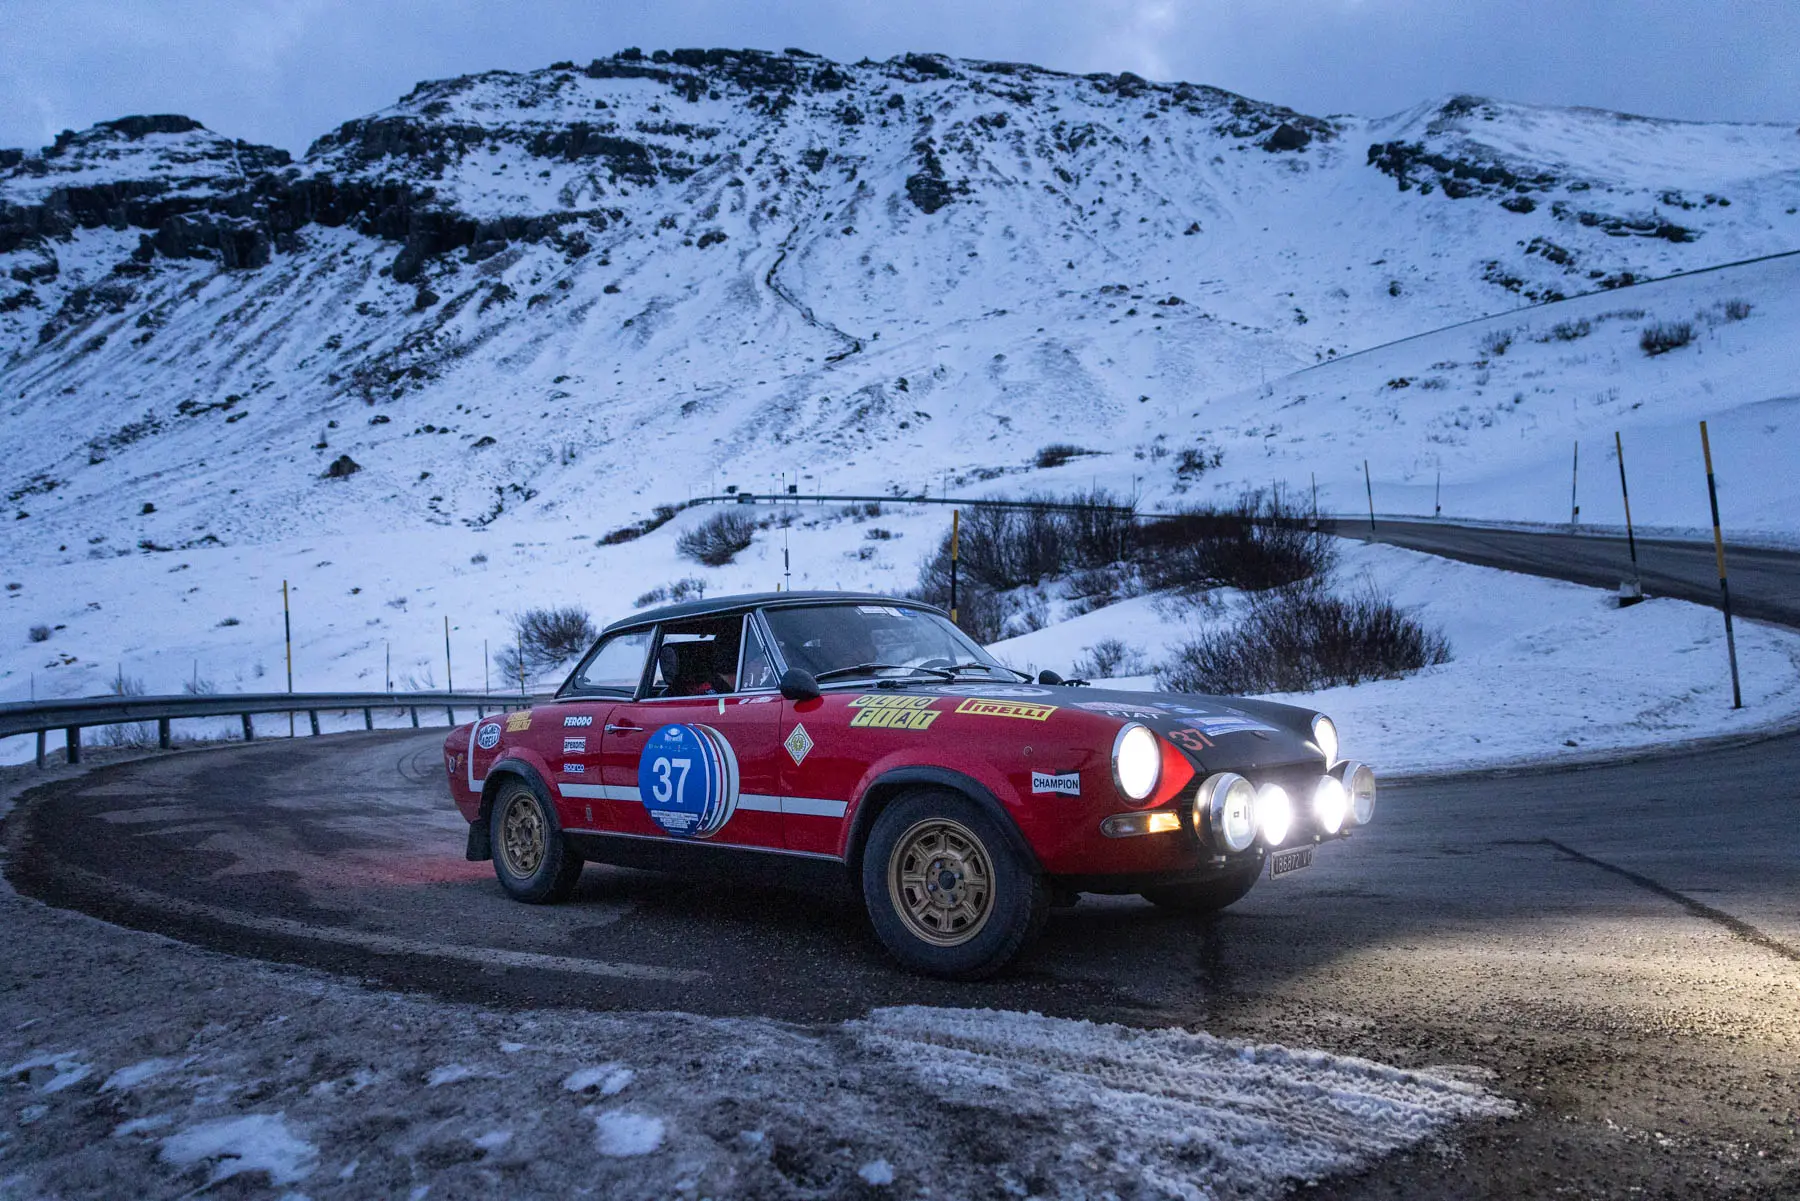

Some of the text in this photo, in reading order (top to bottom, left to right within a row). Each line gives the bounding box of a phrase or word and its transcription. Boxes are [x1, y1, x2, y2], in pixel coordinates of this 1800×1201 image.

[855, 695, 930, 707] OLIO
[961, 700, 1053, 718] PIRELLI
[1106, 710, 1159, 720] FIAT
[563, 716, 593, 727] FERODO
[857, 709, 935, 726] FIAT
[1168, 728, 1216, 751] 37
[652, 756, 692, 803] 37
[1033, 778, 1079, 790] CHAMPION
